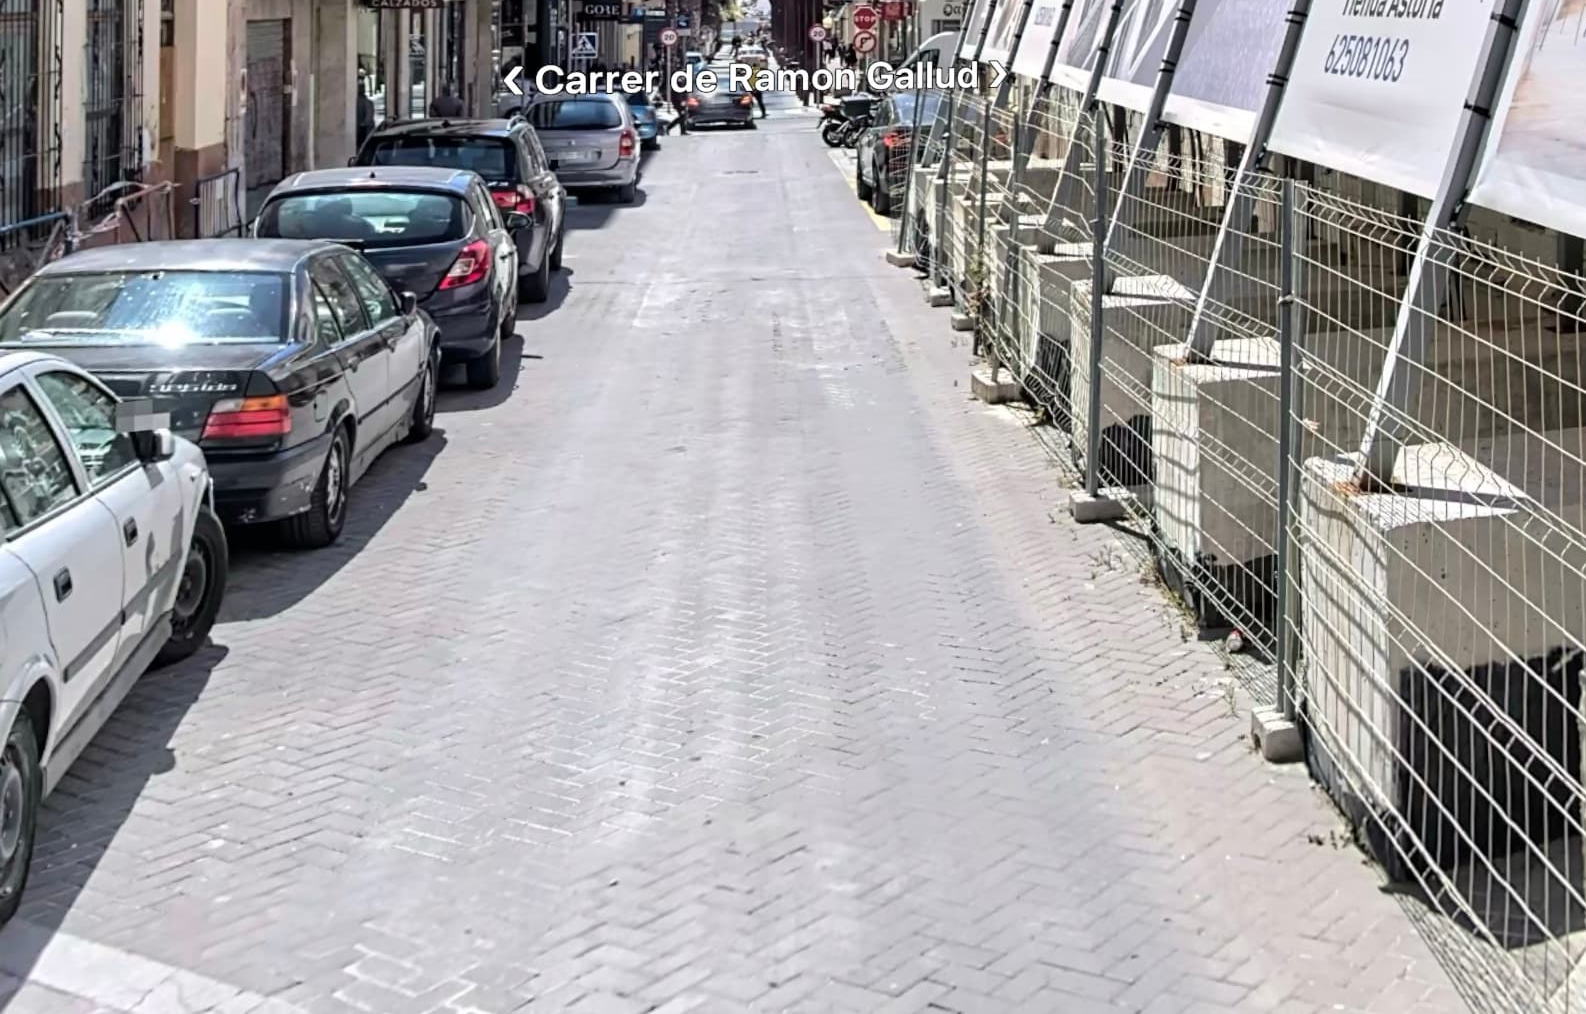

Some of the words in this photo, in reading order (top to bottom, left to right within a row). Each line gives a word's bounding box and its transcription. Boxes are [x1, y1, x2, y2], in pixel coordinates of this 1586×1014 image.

[854, 14, 877, 23] STOP
[663, 32, 675, 41] 20
[813, 29, 824, 38] 20
[1323, 33, 1410, 83] 625081063
